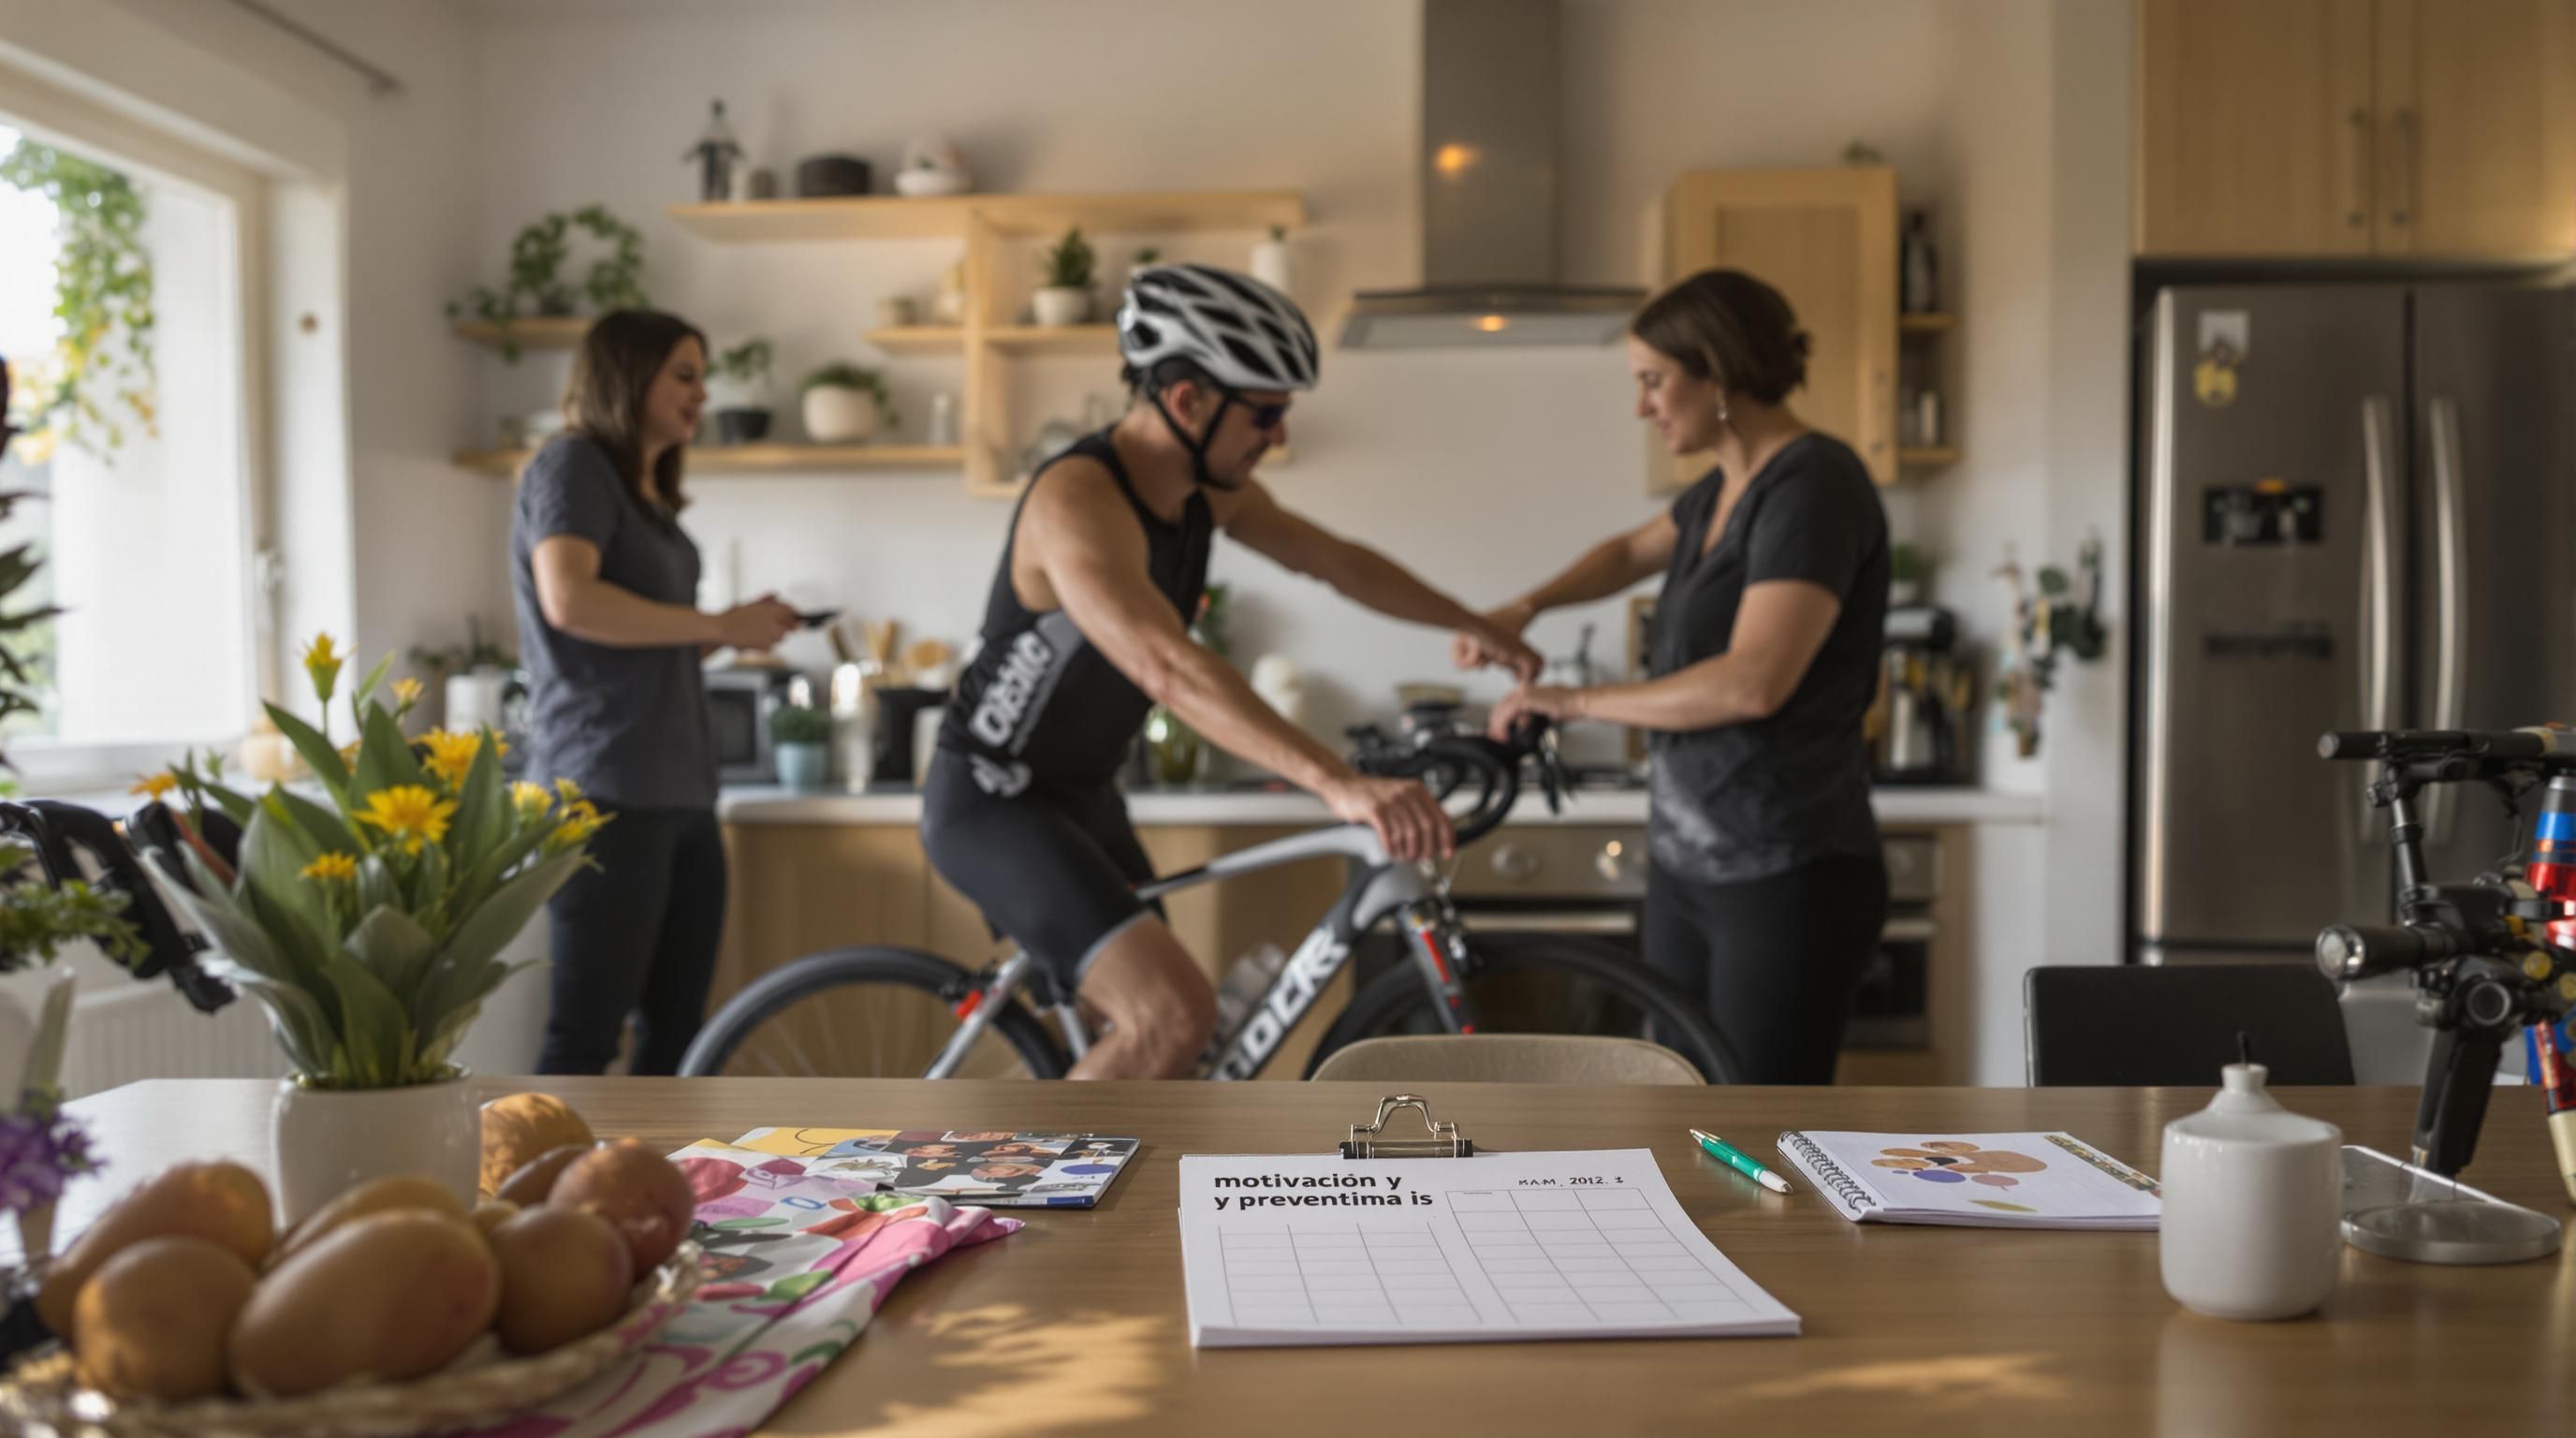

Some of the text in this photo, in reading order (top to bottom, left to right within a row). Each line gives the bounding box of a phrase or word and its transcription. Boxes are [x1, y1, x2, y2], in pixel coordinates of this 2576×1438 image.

[1214, 1174, 1402, 1190] motivación y
[1214, 1191, 1433, 1211] y preventima is
